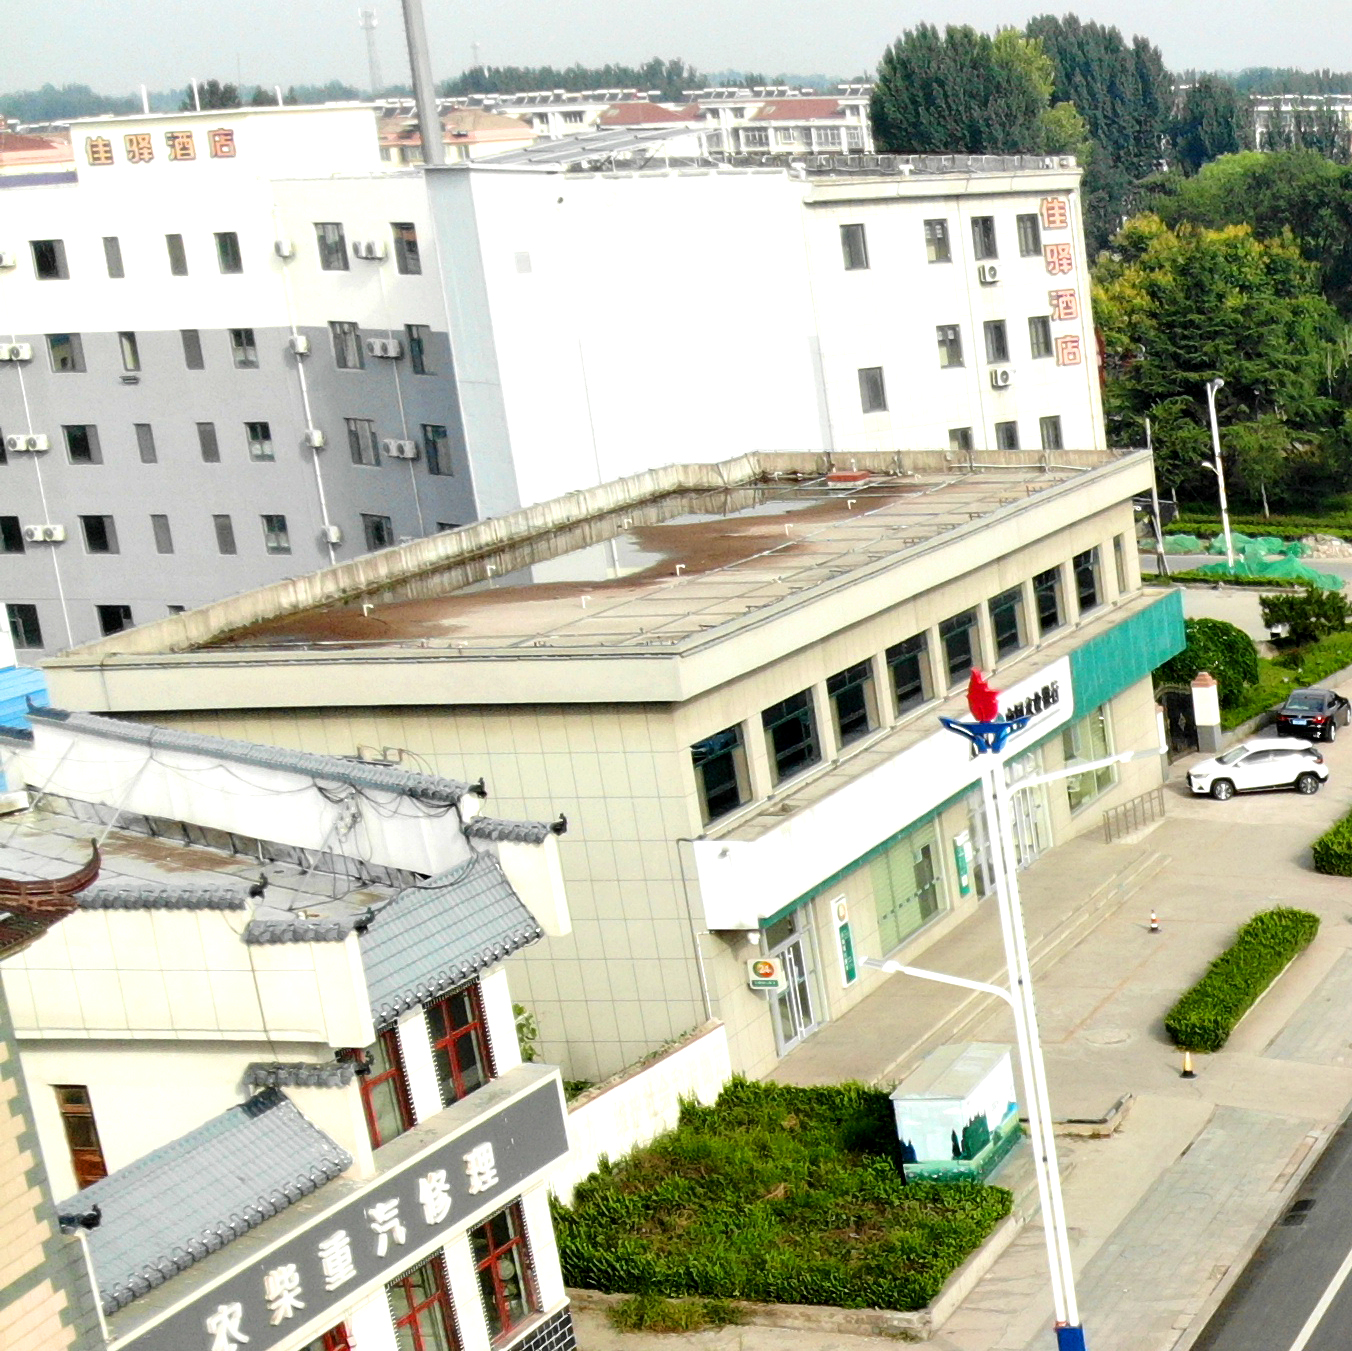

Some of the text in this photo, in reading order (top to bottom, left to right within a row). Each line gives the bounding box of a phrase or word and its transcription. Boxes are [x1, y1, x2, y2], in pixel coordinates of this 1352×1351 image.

[85, 128, 236, 166] 佳驿酒店
[1039, 197, 1082, 367] 佳驿酒店
